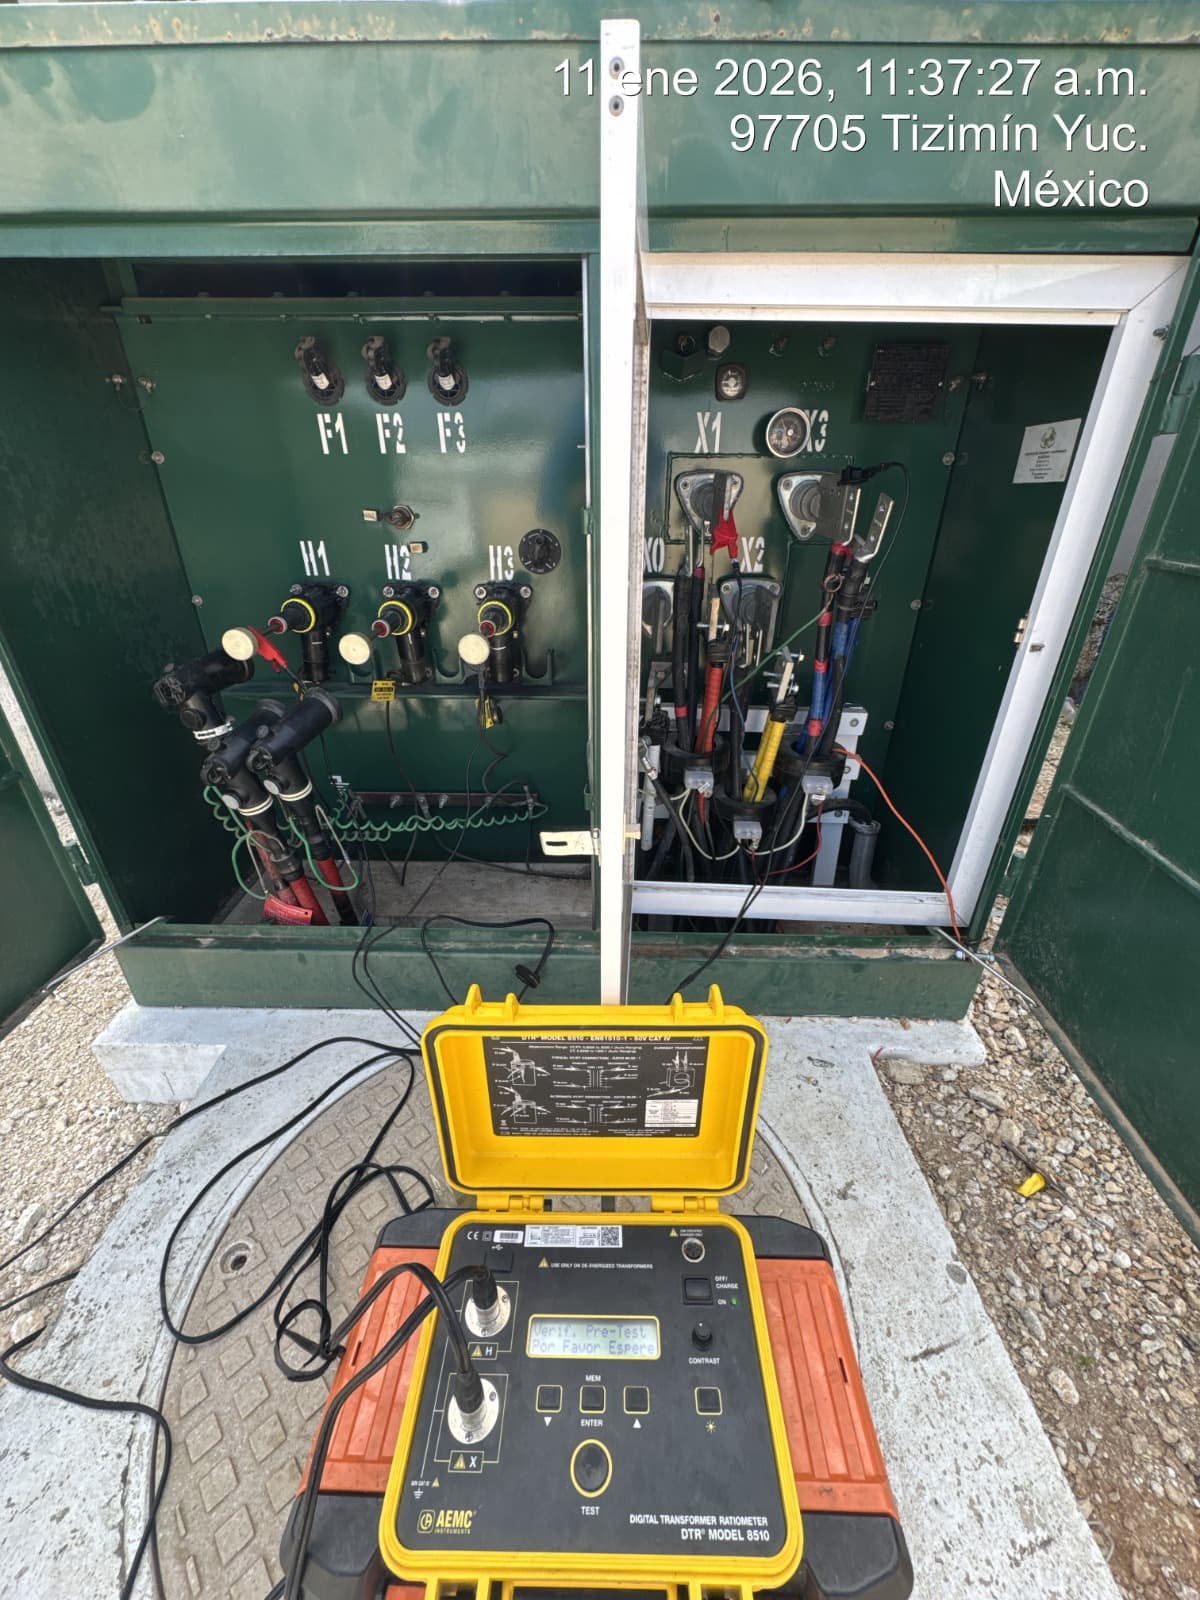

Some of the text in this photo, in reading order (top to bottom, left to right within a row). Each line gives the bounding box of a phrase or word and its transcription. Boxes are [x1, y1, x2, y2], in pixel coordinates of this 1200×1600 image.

[317, 412, 349, 455] F1
[375, 412, 407, 454] F2
[436, 412, 466, 453] F3
[694, 411, 722, 453] X1
[299, 540, 330, 576] H1
[384, 544, 412, 581] H2
[488, 545, 515, 581] H3
[739, 536, 766, 573] X2
[534, 1322, 647, 1339] Verif. Pre-Test
[485, 1345, 493, 1357] H
[532, 1339, 655, 1355] Por Favor Espere
[688, 1357, 721, 1365] CONTRAST
[580, 1419, 604, 1427] ENTER
[469, 1455, 478, 1468] X
[580, 1506, 601, 1516] TEST
[629, 1514, 769, 1527] DIGITAL TRANSFORMER RATIOMETER
[708, 1529, 745, 1541] MODEL
[746, 1530, 770, 1542] 8510
